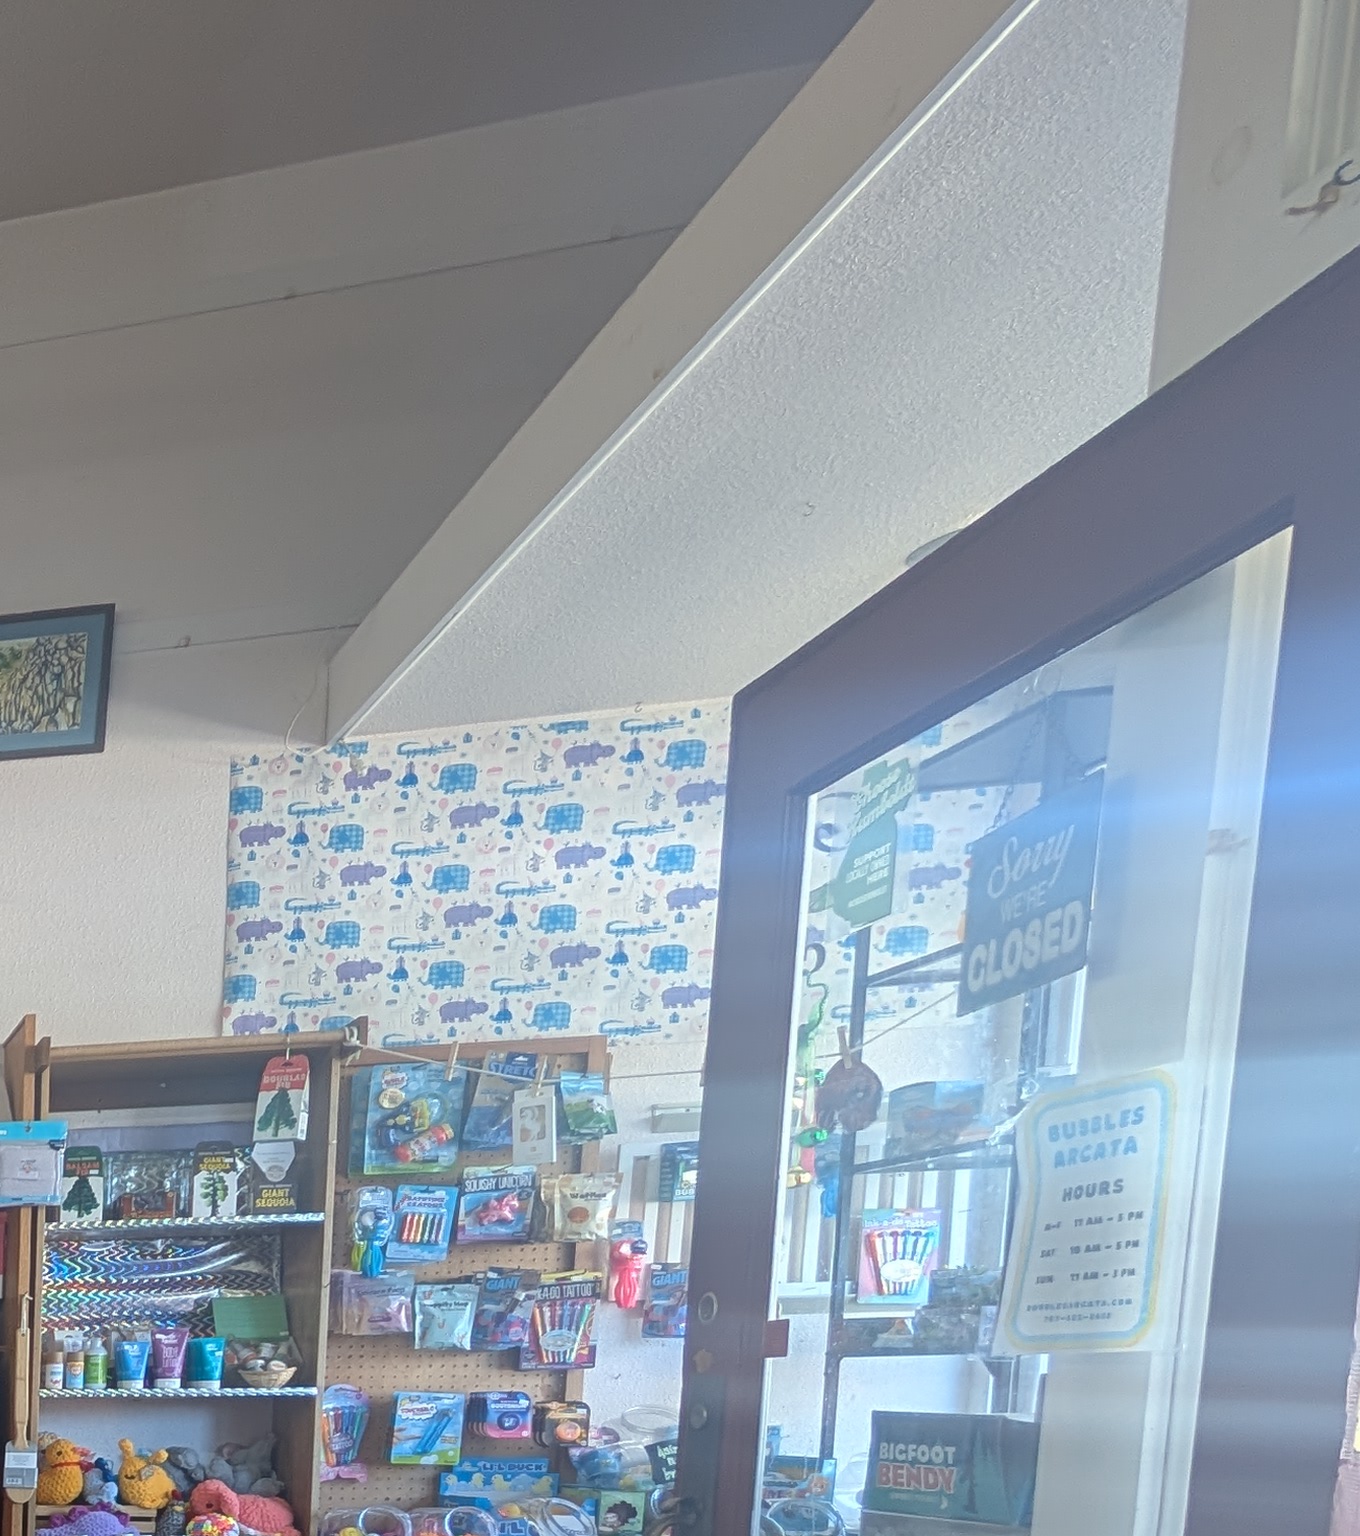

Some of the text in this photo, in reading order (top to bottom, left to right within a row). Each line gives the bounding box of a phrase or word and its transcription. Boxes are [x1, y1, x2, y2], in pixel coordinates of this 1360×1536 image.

[853, 842, 892, 868] SUPPORT
[987, 824, 1075, 899] Sorry
[867, 866, 890, 885] HERE
[967, 900, 1084, 992] CLOSED
[1048, 1105, 1145, 1143] BUBBLES
[1054, 1135, 1138, 1169] ARCATA
[199, 1163, 231, 1171] SEQUOIA
[262, 1188, 290, 1198] GIANT
[465, 1176, 533, 1193] SQUISHY UNICORN
[1061, 1178, 1124, 1202] HOURS
[255, 1198, 295, 1208] SEQUOIA
[1127, 1211, 1144, 1221] PM
[1084, 1244, 1101, 1253] AM
[1124, 1239, 1140, 1249] PM
[652, 1272, 687, 1287] GIANT
[1082, 1271, 1099, 1280] AM
[1120, 1267, 1136, 1277] PM
[486, 1277, 520, 1291] GIANT
[880, 1442, 956, 1465] BIGFOOT
[508, 1463, 545, 1471] DUCK
[877, 1463, 957, 1493] BENDY
